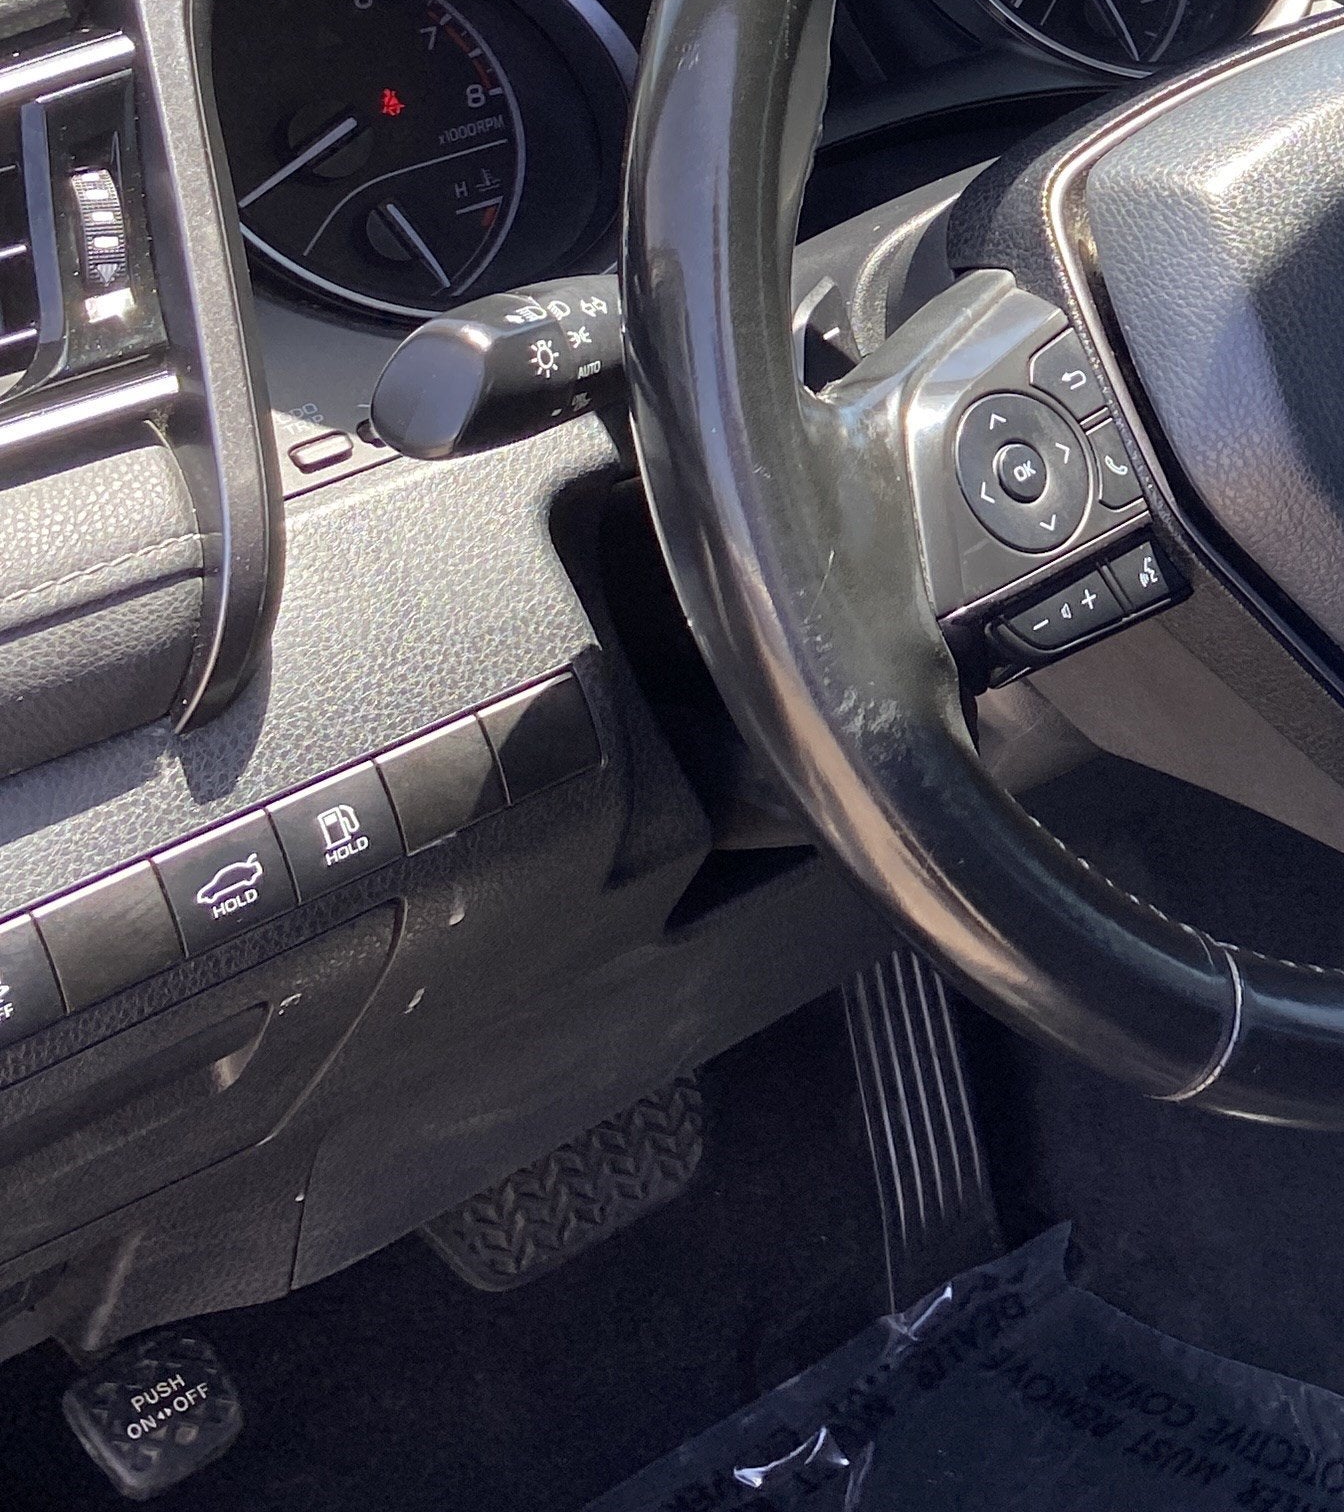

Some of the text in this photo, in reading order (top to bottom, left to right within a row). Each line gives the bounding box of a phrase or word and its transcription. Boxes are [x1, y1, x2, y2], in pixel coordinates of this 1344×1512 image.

[420, 26, 437, 51] 7
[465, 85, 486, 108] 8
[454, 181, 469, 199] H
[577, 361, 602, 381] AUTO
[1013, 461, 1036, 480] OK
[324, 834, 370, 867] HOLD
[210, 887, 259, 920] HOLD
[130, 1372, 187, 1414] PUSH
[126, 1381, 210, 1440] ON OFF
